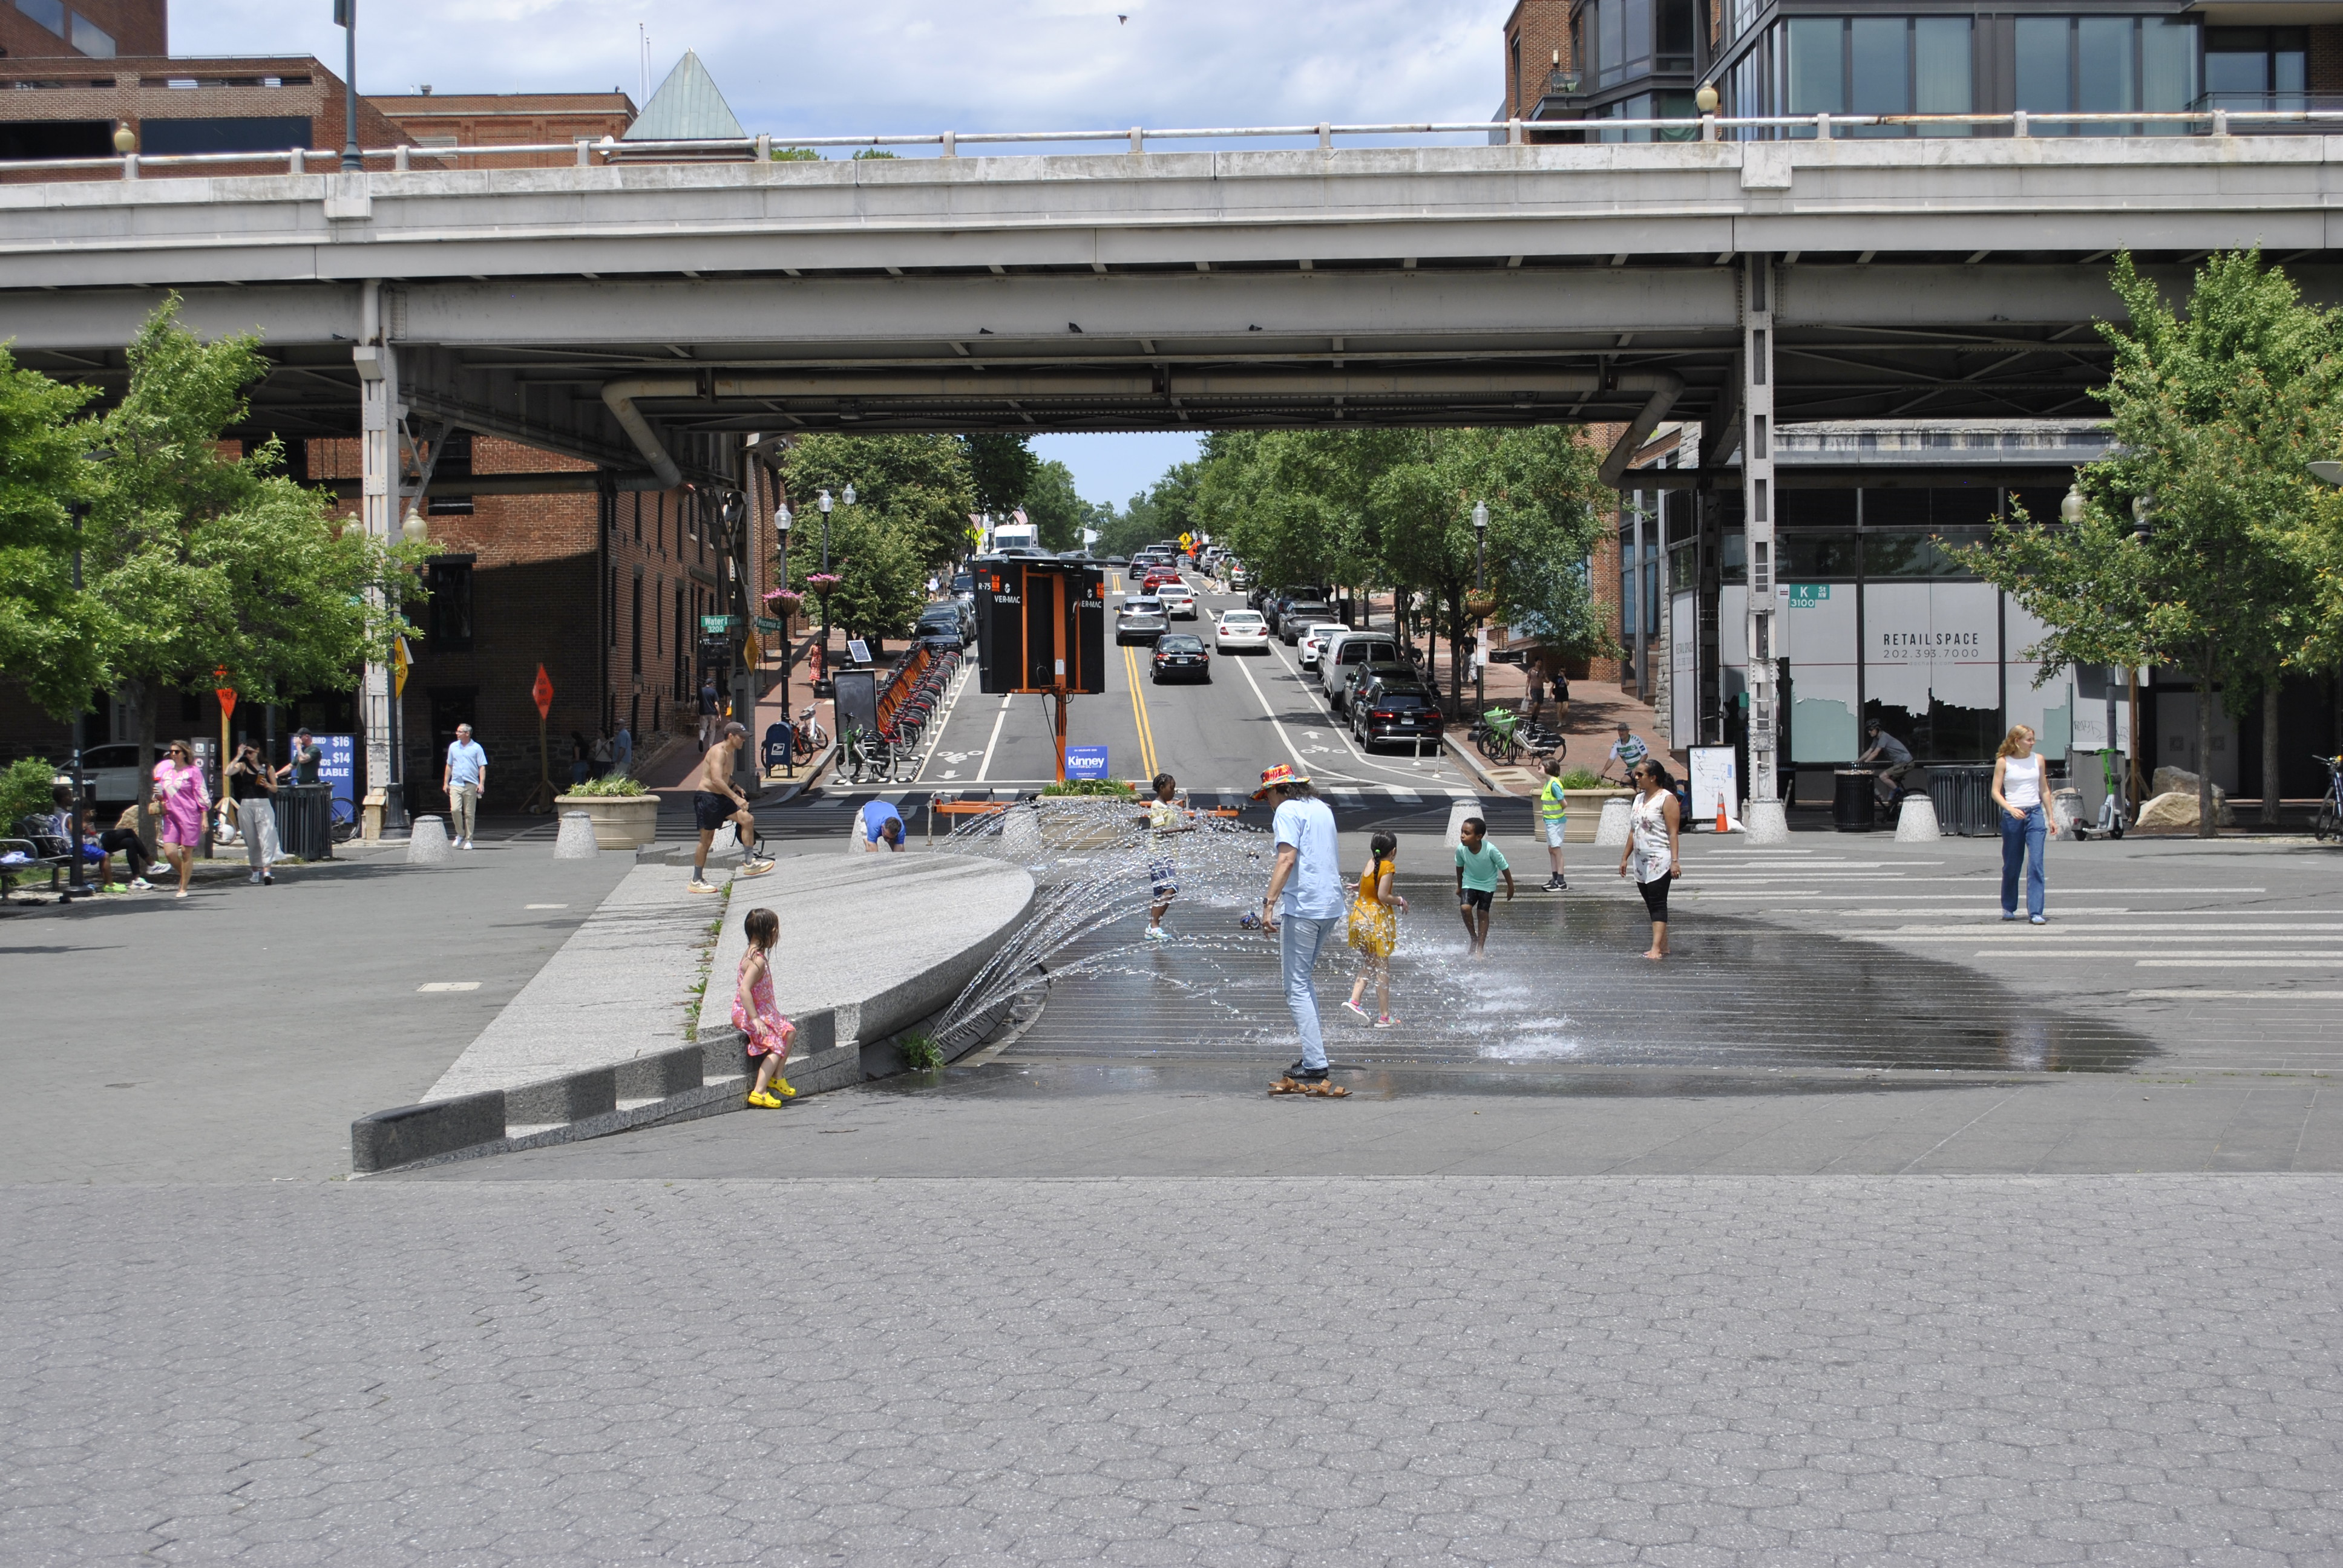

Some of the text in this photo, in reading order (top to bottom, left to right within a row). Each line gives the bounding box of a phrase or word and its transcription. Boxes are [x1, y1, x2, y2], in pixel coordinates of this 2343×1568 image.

[1800, 586, 1809, 598] K
[994, 595, 1021, 604] VER-MAC
[705, 617, 724, 626] Water
[1884, 633, 1979, 645] RETAIL SPACE
[1884, 649, 1979, 658] 202.393.7000
[332, 736, 350, 748] $16
[333, 752, 351, 764] $14
[1068, 756, 1105, 768] Kinney
